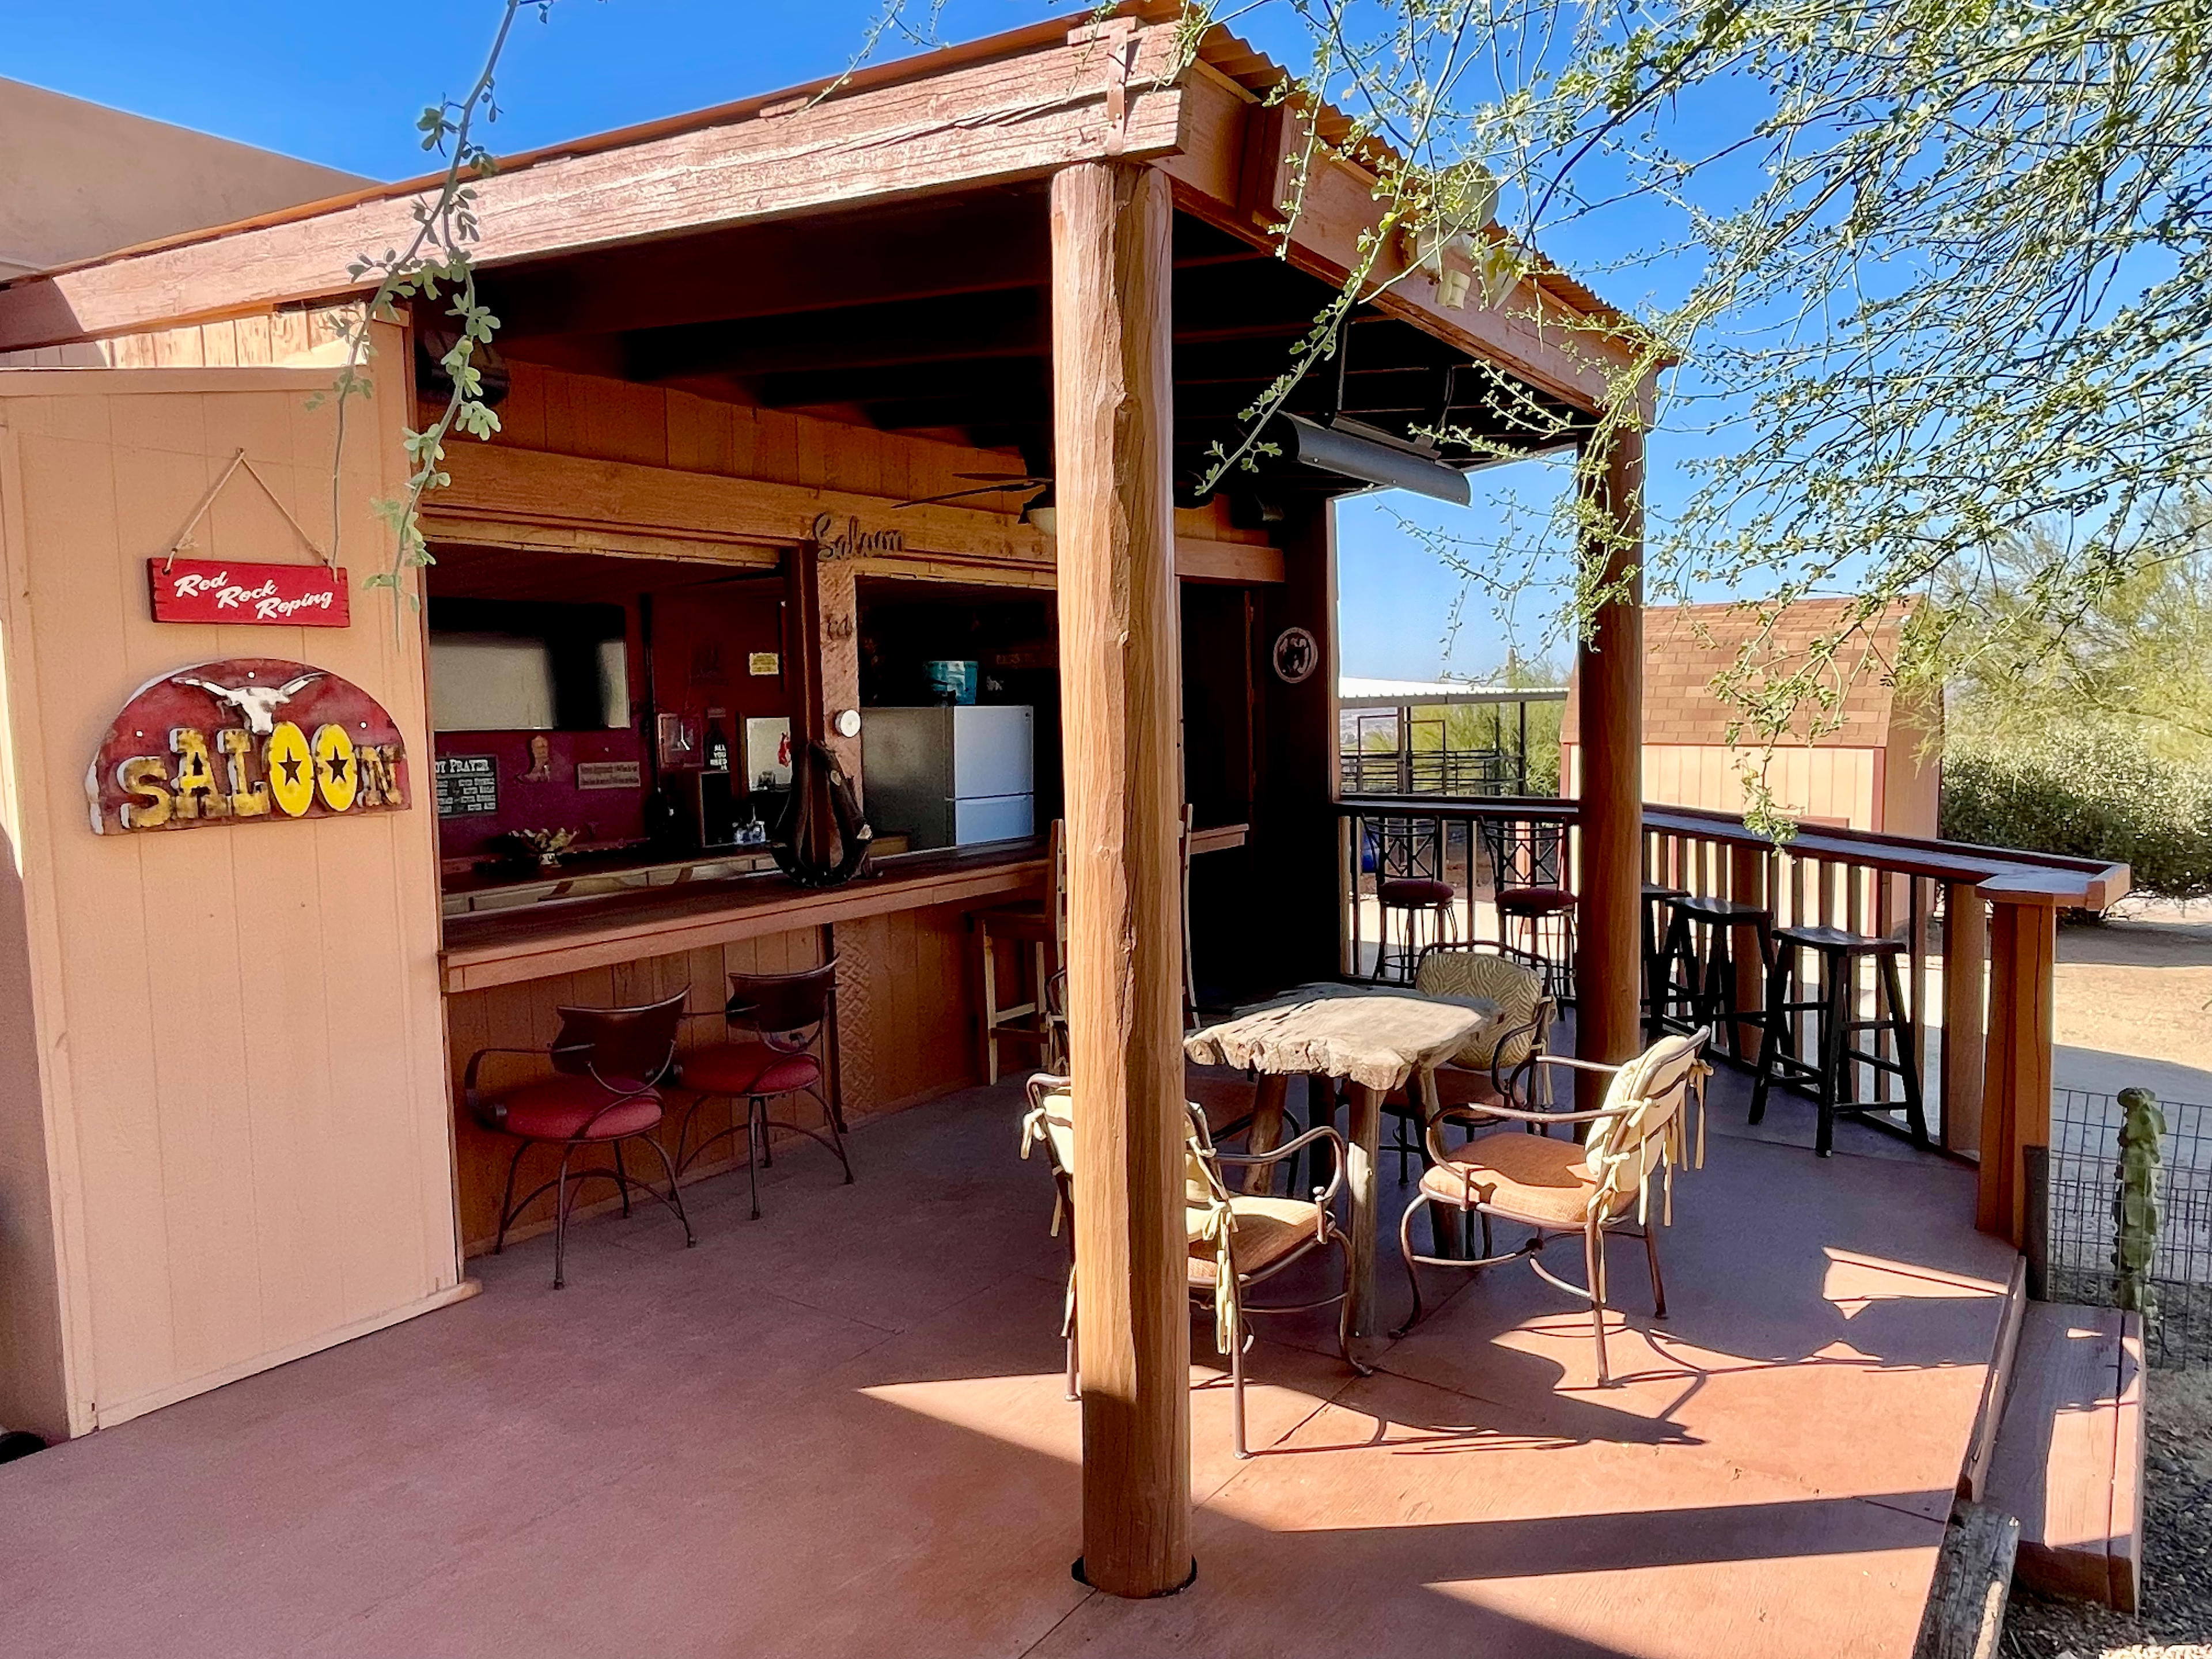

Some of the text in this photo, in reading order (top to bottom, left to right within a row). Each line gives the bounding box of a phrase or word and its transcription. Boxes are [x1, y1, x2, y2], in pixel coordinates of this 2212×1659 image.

[812, 511, 903, 561] Saloon
[174, 571, 229, 598] Red
[215, 579, 278, 609] Rock
[255, 591, 333, 619] Roping
[118, 721, 404, 828] SALOON
